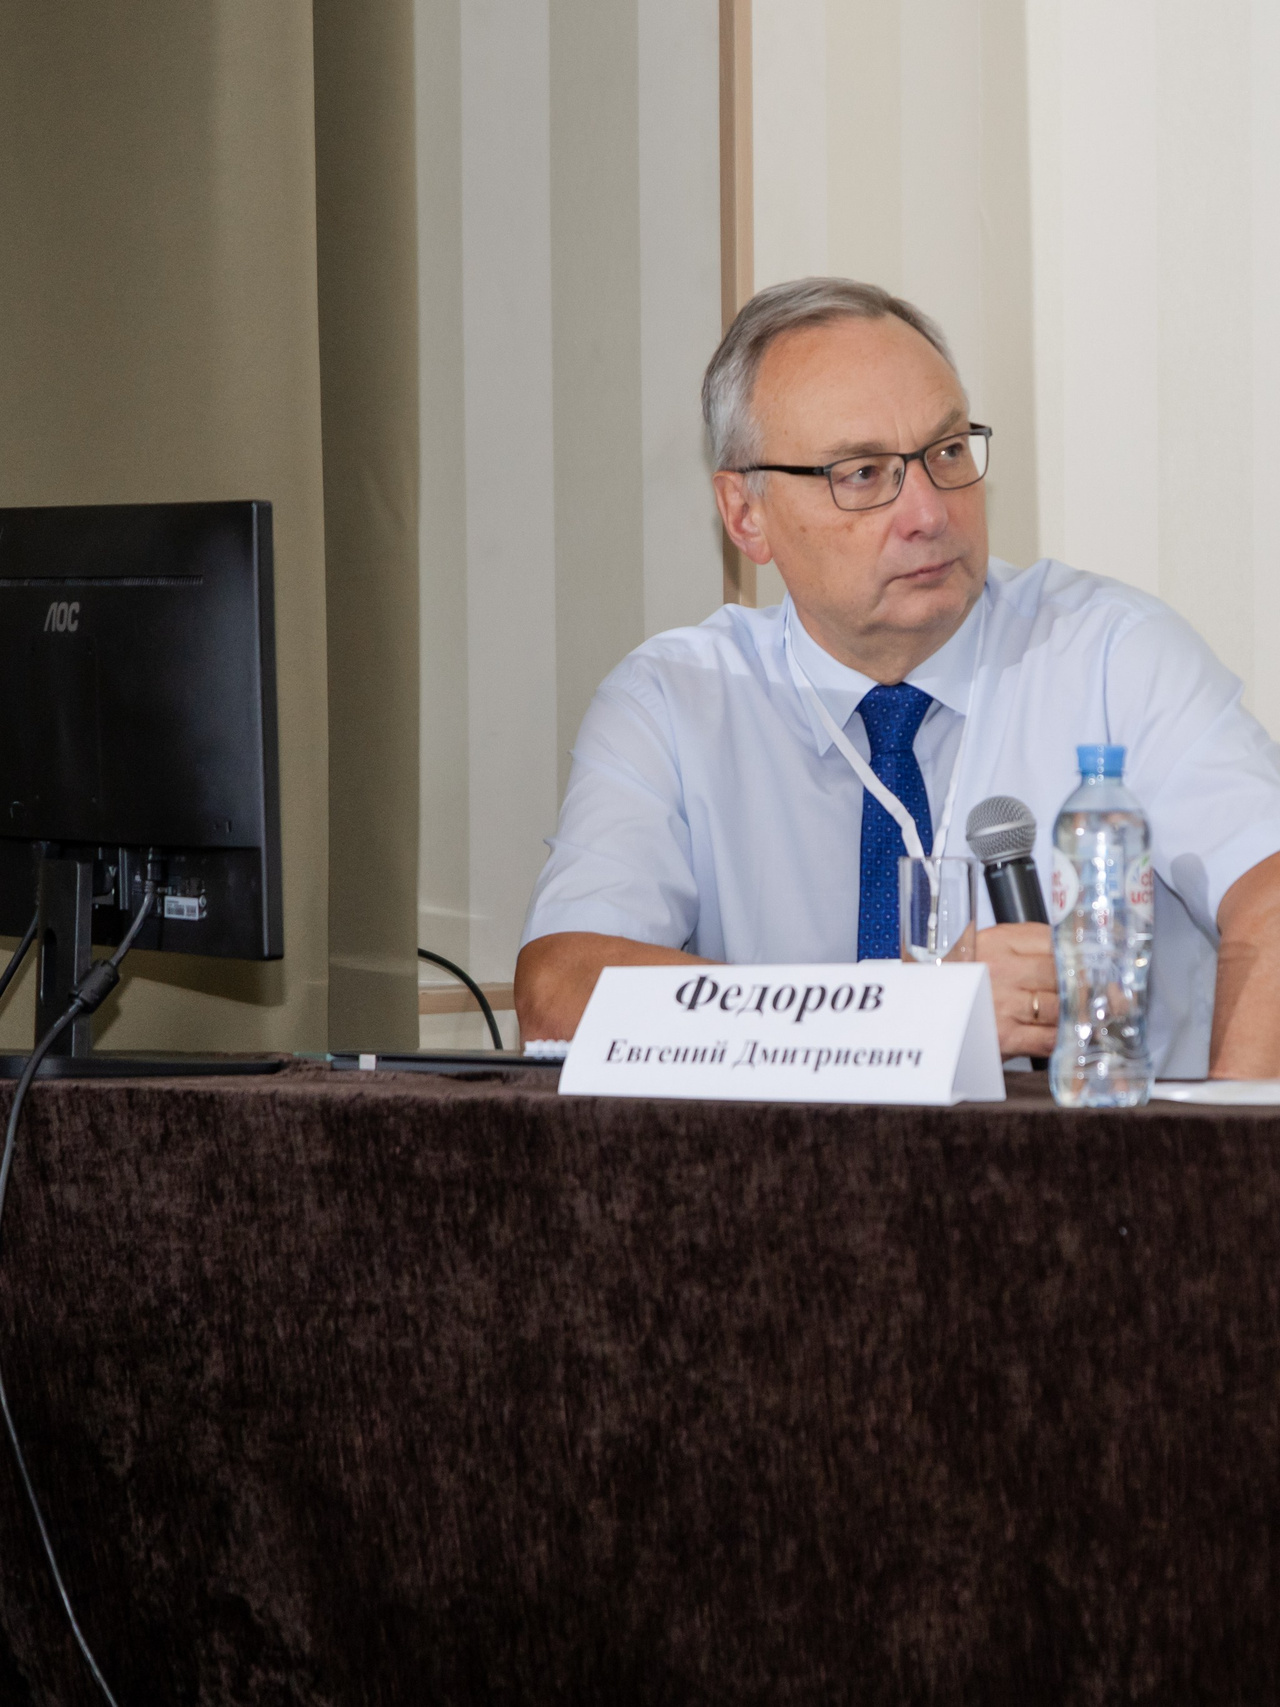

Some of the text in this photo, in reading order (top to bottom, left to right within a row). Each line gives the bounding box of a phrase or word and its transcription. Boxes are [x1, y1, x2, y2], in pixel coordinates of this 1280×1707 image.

[43, 601, 80, 632] AOC
[674, 974, 885, 1023] Федоров
[604, 1038, 924, 1073] Евгений Дмитриевич
